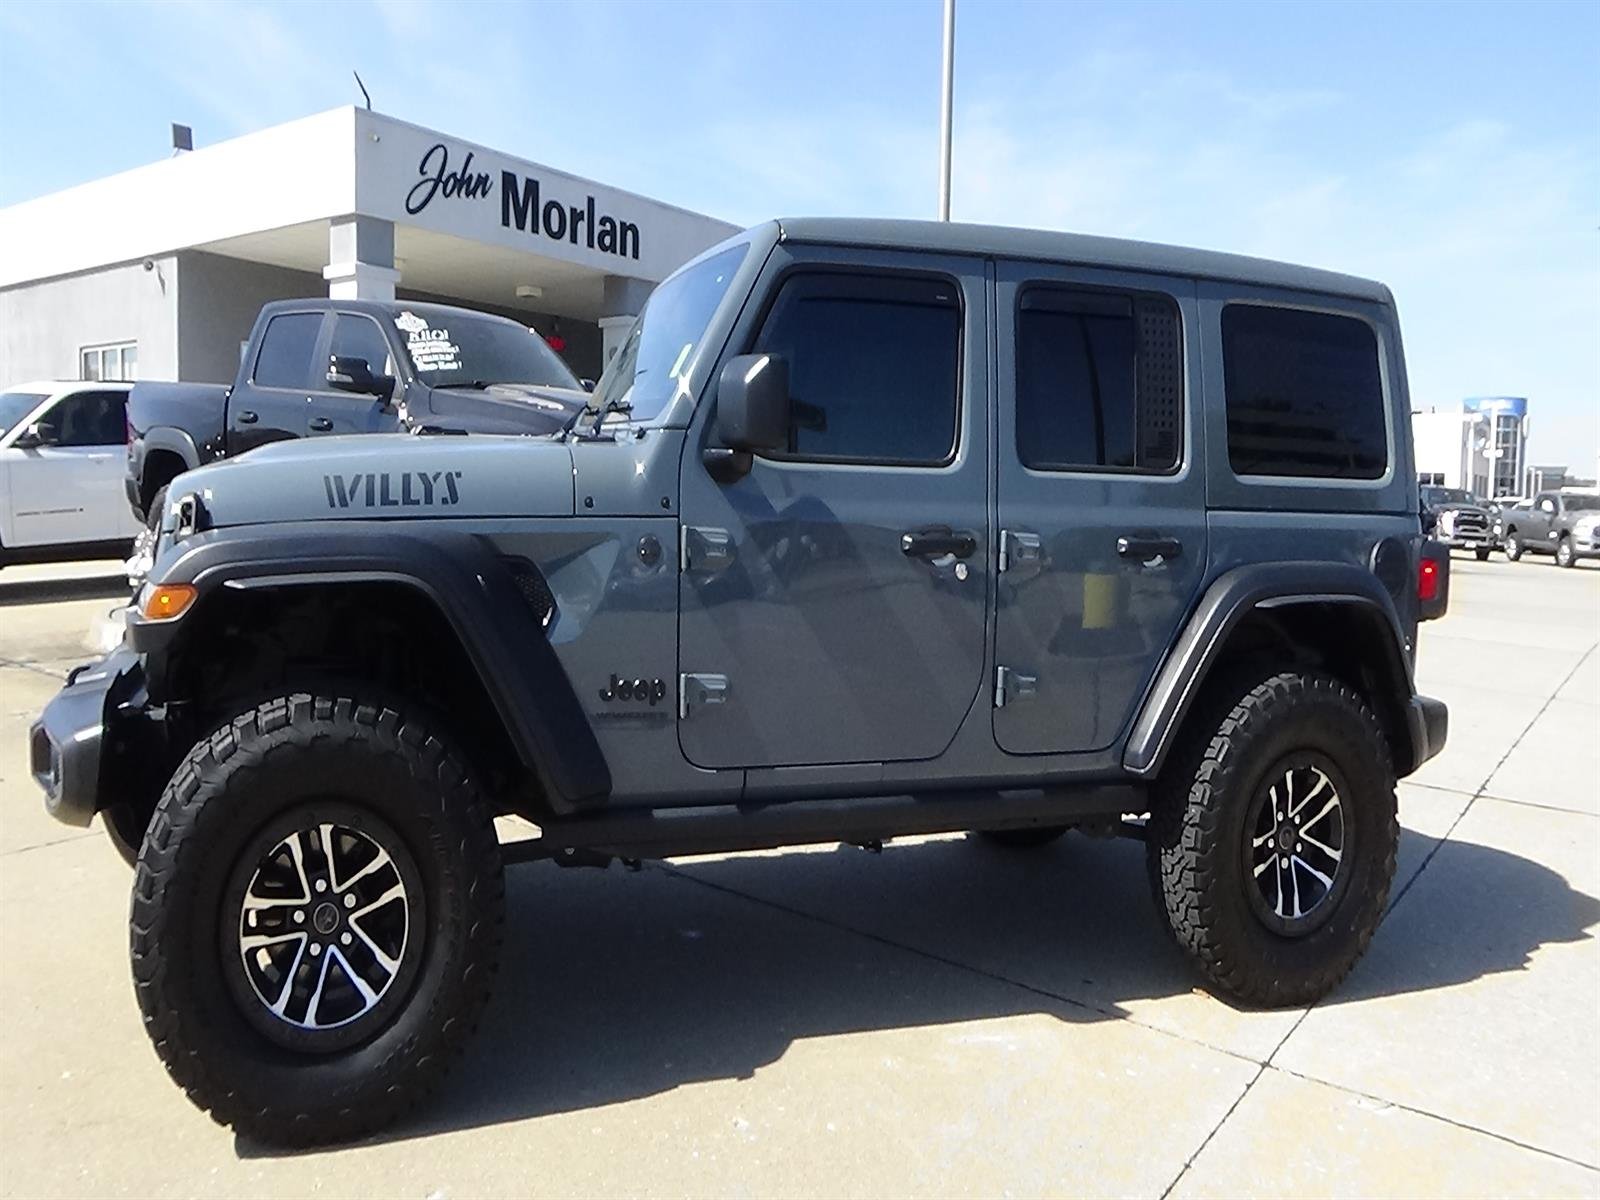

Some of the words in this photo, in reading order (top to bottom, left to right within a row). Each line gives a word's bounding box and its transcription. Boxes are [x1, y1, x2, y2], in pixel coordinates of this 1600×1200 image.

[405, 143, 493, 215] John
[501, 169, 640, 260] Morlan
[323, 471, 462, 508] WILLYS
[599, 673, 666, 706] Jeep
